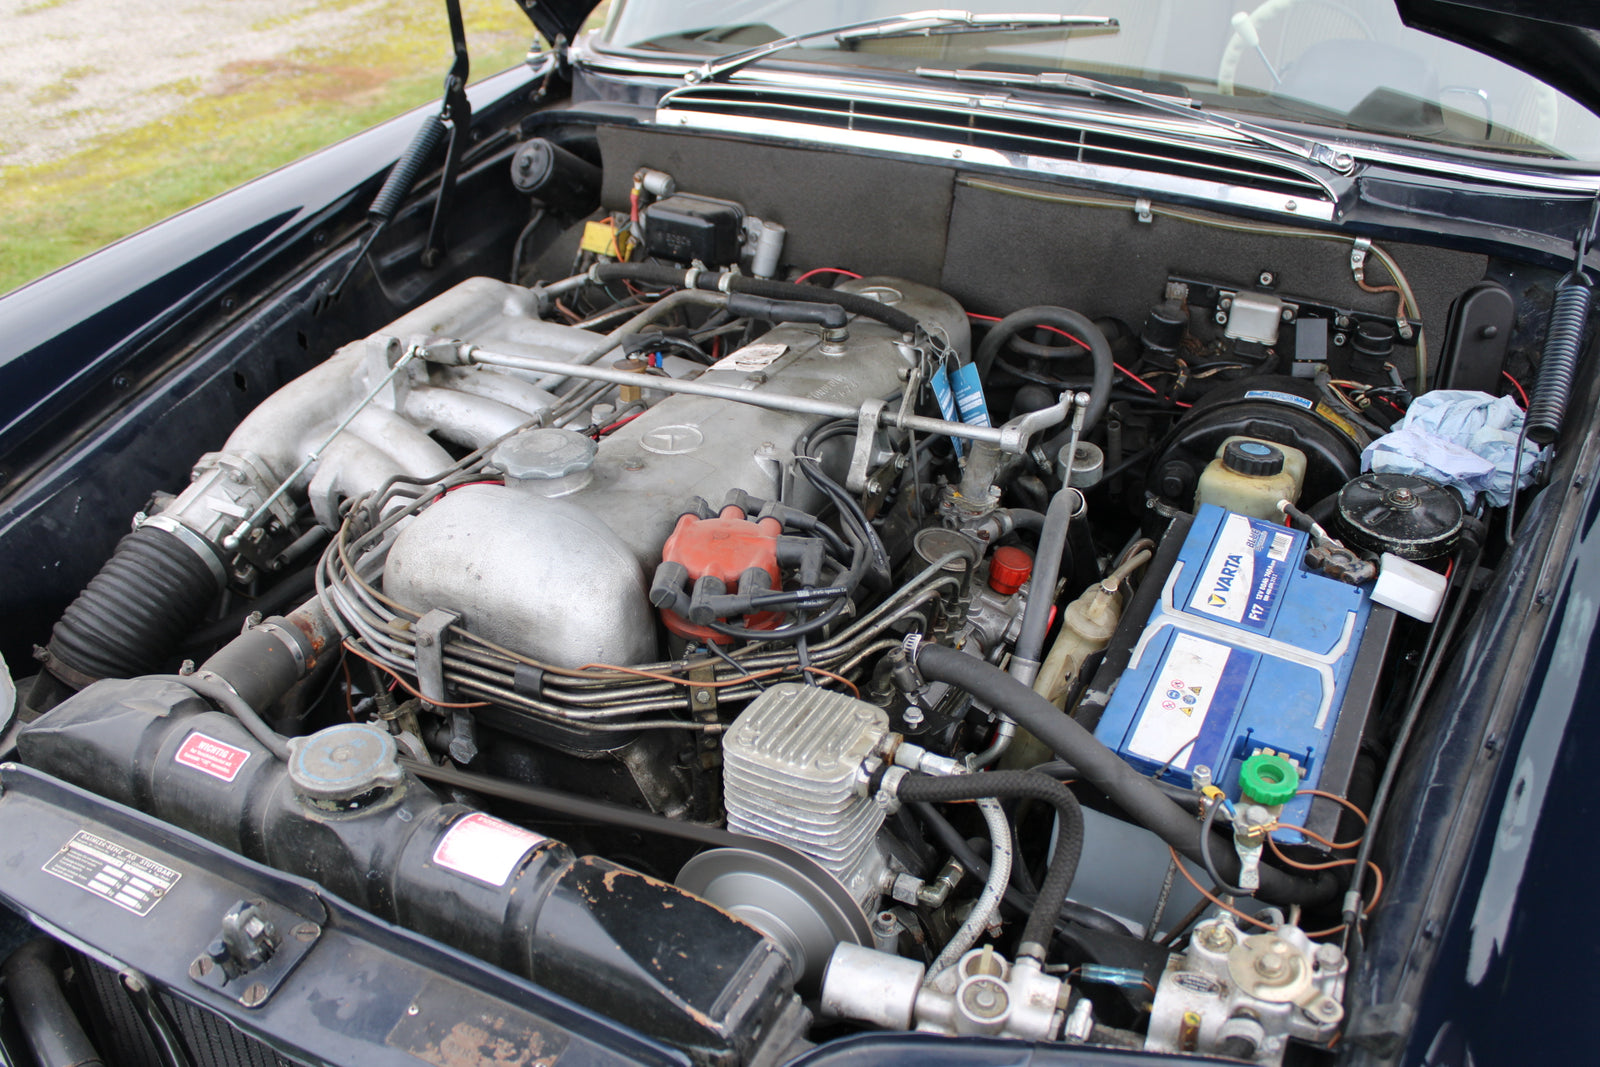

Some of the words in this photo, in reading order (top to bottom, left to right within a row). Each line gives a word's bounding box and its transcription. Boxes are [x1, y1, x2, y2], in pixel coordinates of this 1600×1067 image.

[1246, 527, 1261, 549] BLUE
[1214, 554, 1243, 592] VARTA
[1248, 603, 1265, 621] F17
[197, 741, 230, 759] WICHTIG
[125, 853, 137, 861] AG
[139, 858, 176, 879] STUTTGART
